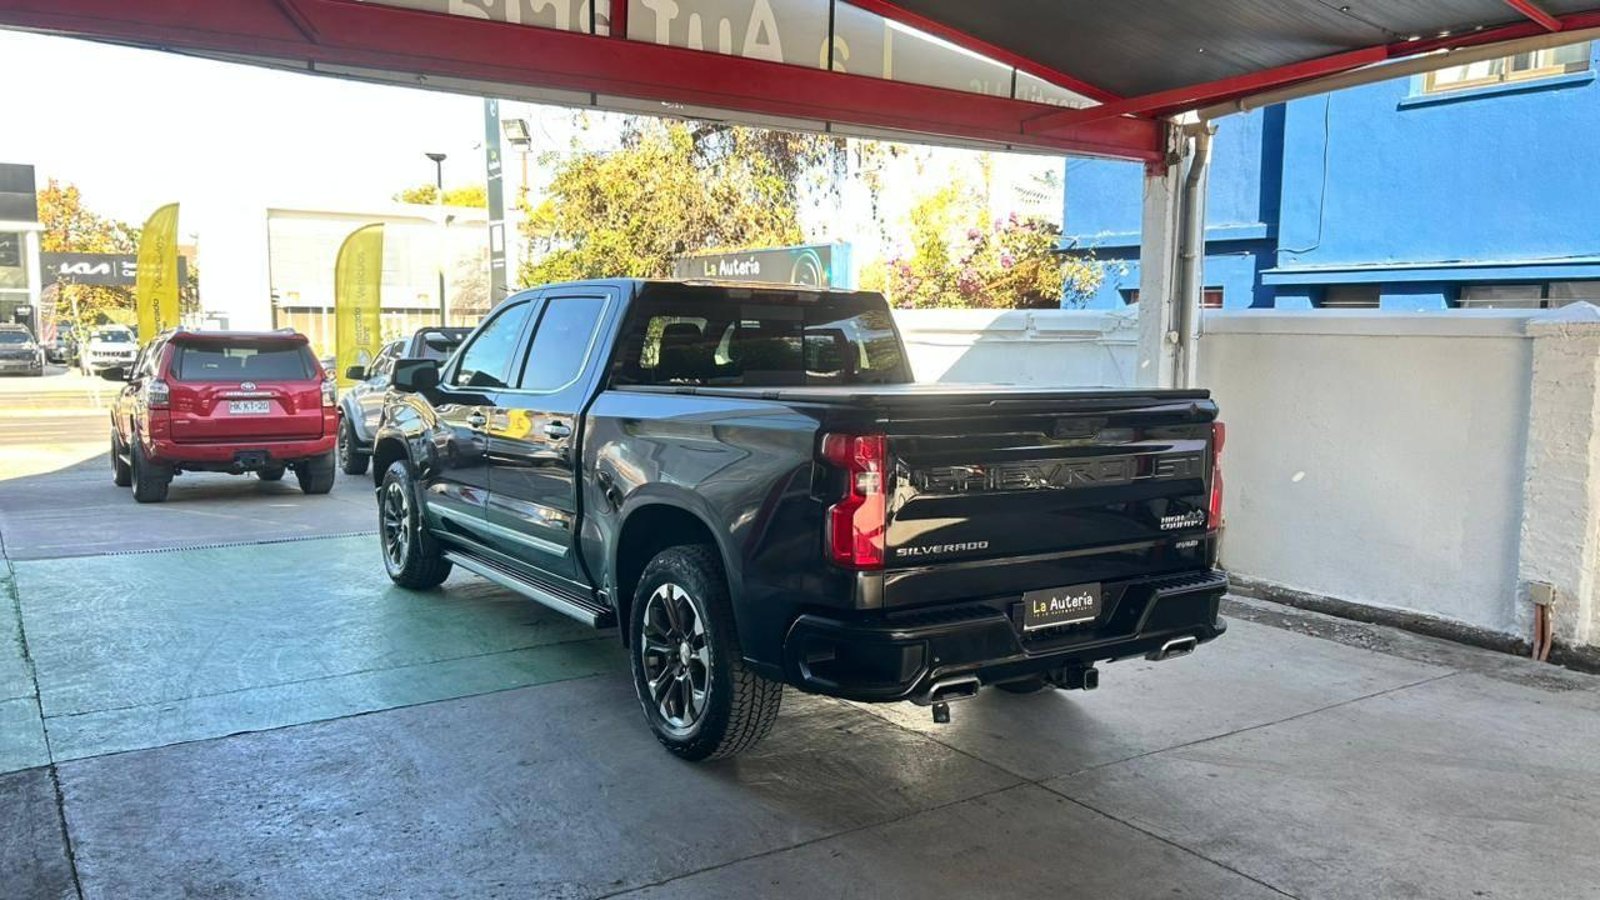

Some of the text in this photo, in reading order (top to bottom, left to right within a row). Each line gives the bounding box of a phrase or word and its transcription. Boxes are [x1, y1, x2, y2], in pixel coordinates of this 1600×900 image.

[703, 256, 760, 277] La Autería
[896, 540, 989, 557] SILVERADO
[1033, 599, 1047, 613] La
[1049, 591, 1094, 611] Autería
